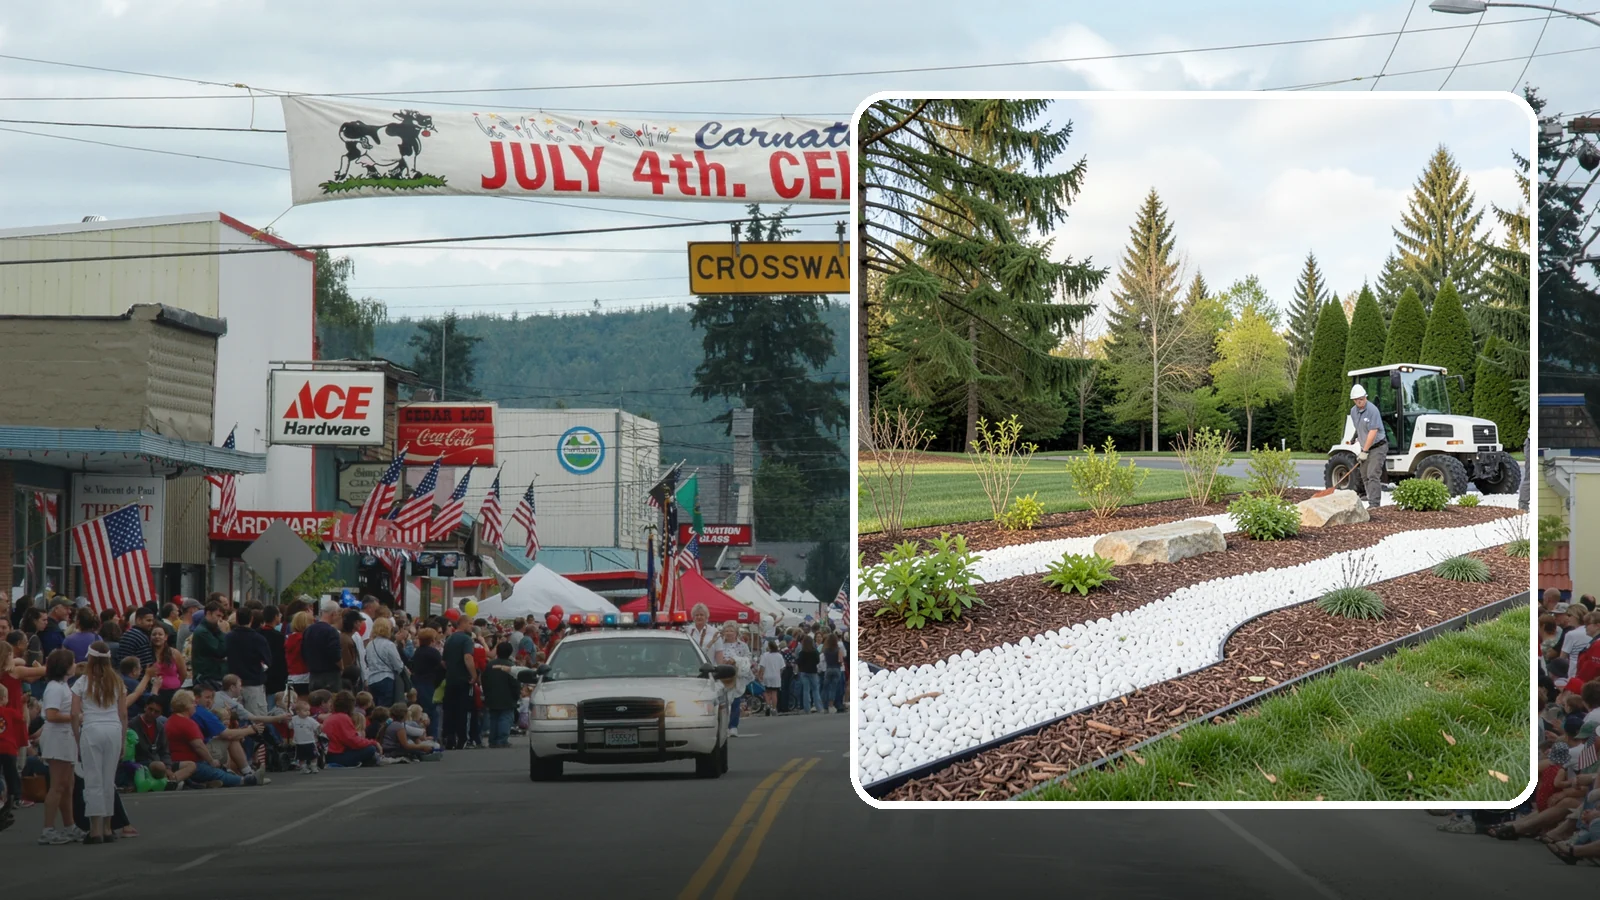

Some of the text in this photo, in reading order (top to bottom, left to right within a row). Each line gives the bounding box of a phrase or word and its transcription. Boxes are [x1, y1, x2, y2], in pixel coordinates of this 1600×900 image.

[695, 121, 850, 150] Carnat
[481, 141, 605, 193] JULY
[632, 149, 747, 198] 4th.
[697, 254, 850, 280] CROSSWA
[283, 380, 373, 420] ACE
[406, 409, 452, 422] CEDAR
[284, 421, 370, 436] Hardware
[416, 428, 476, 447] Coca-Cola
[95, 485, 124, 495] Vincent
[126, 486, 136, 494] de
[138, 486, 155, 495] Paul
[212, 516, 331, 535] HARDARE
[688, 526, 741, 535] CRNATION
[699, 535, 730, 543] GLASS
